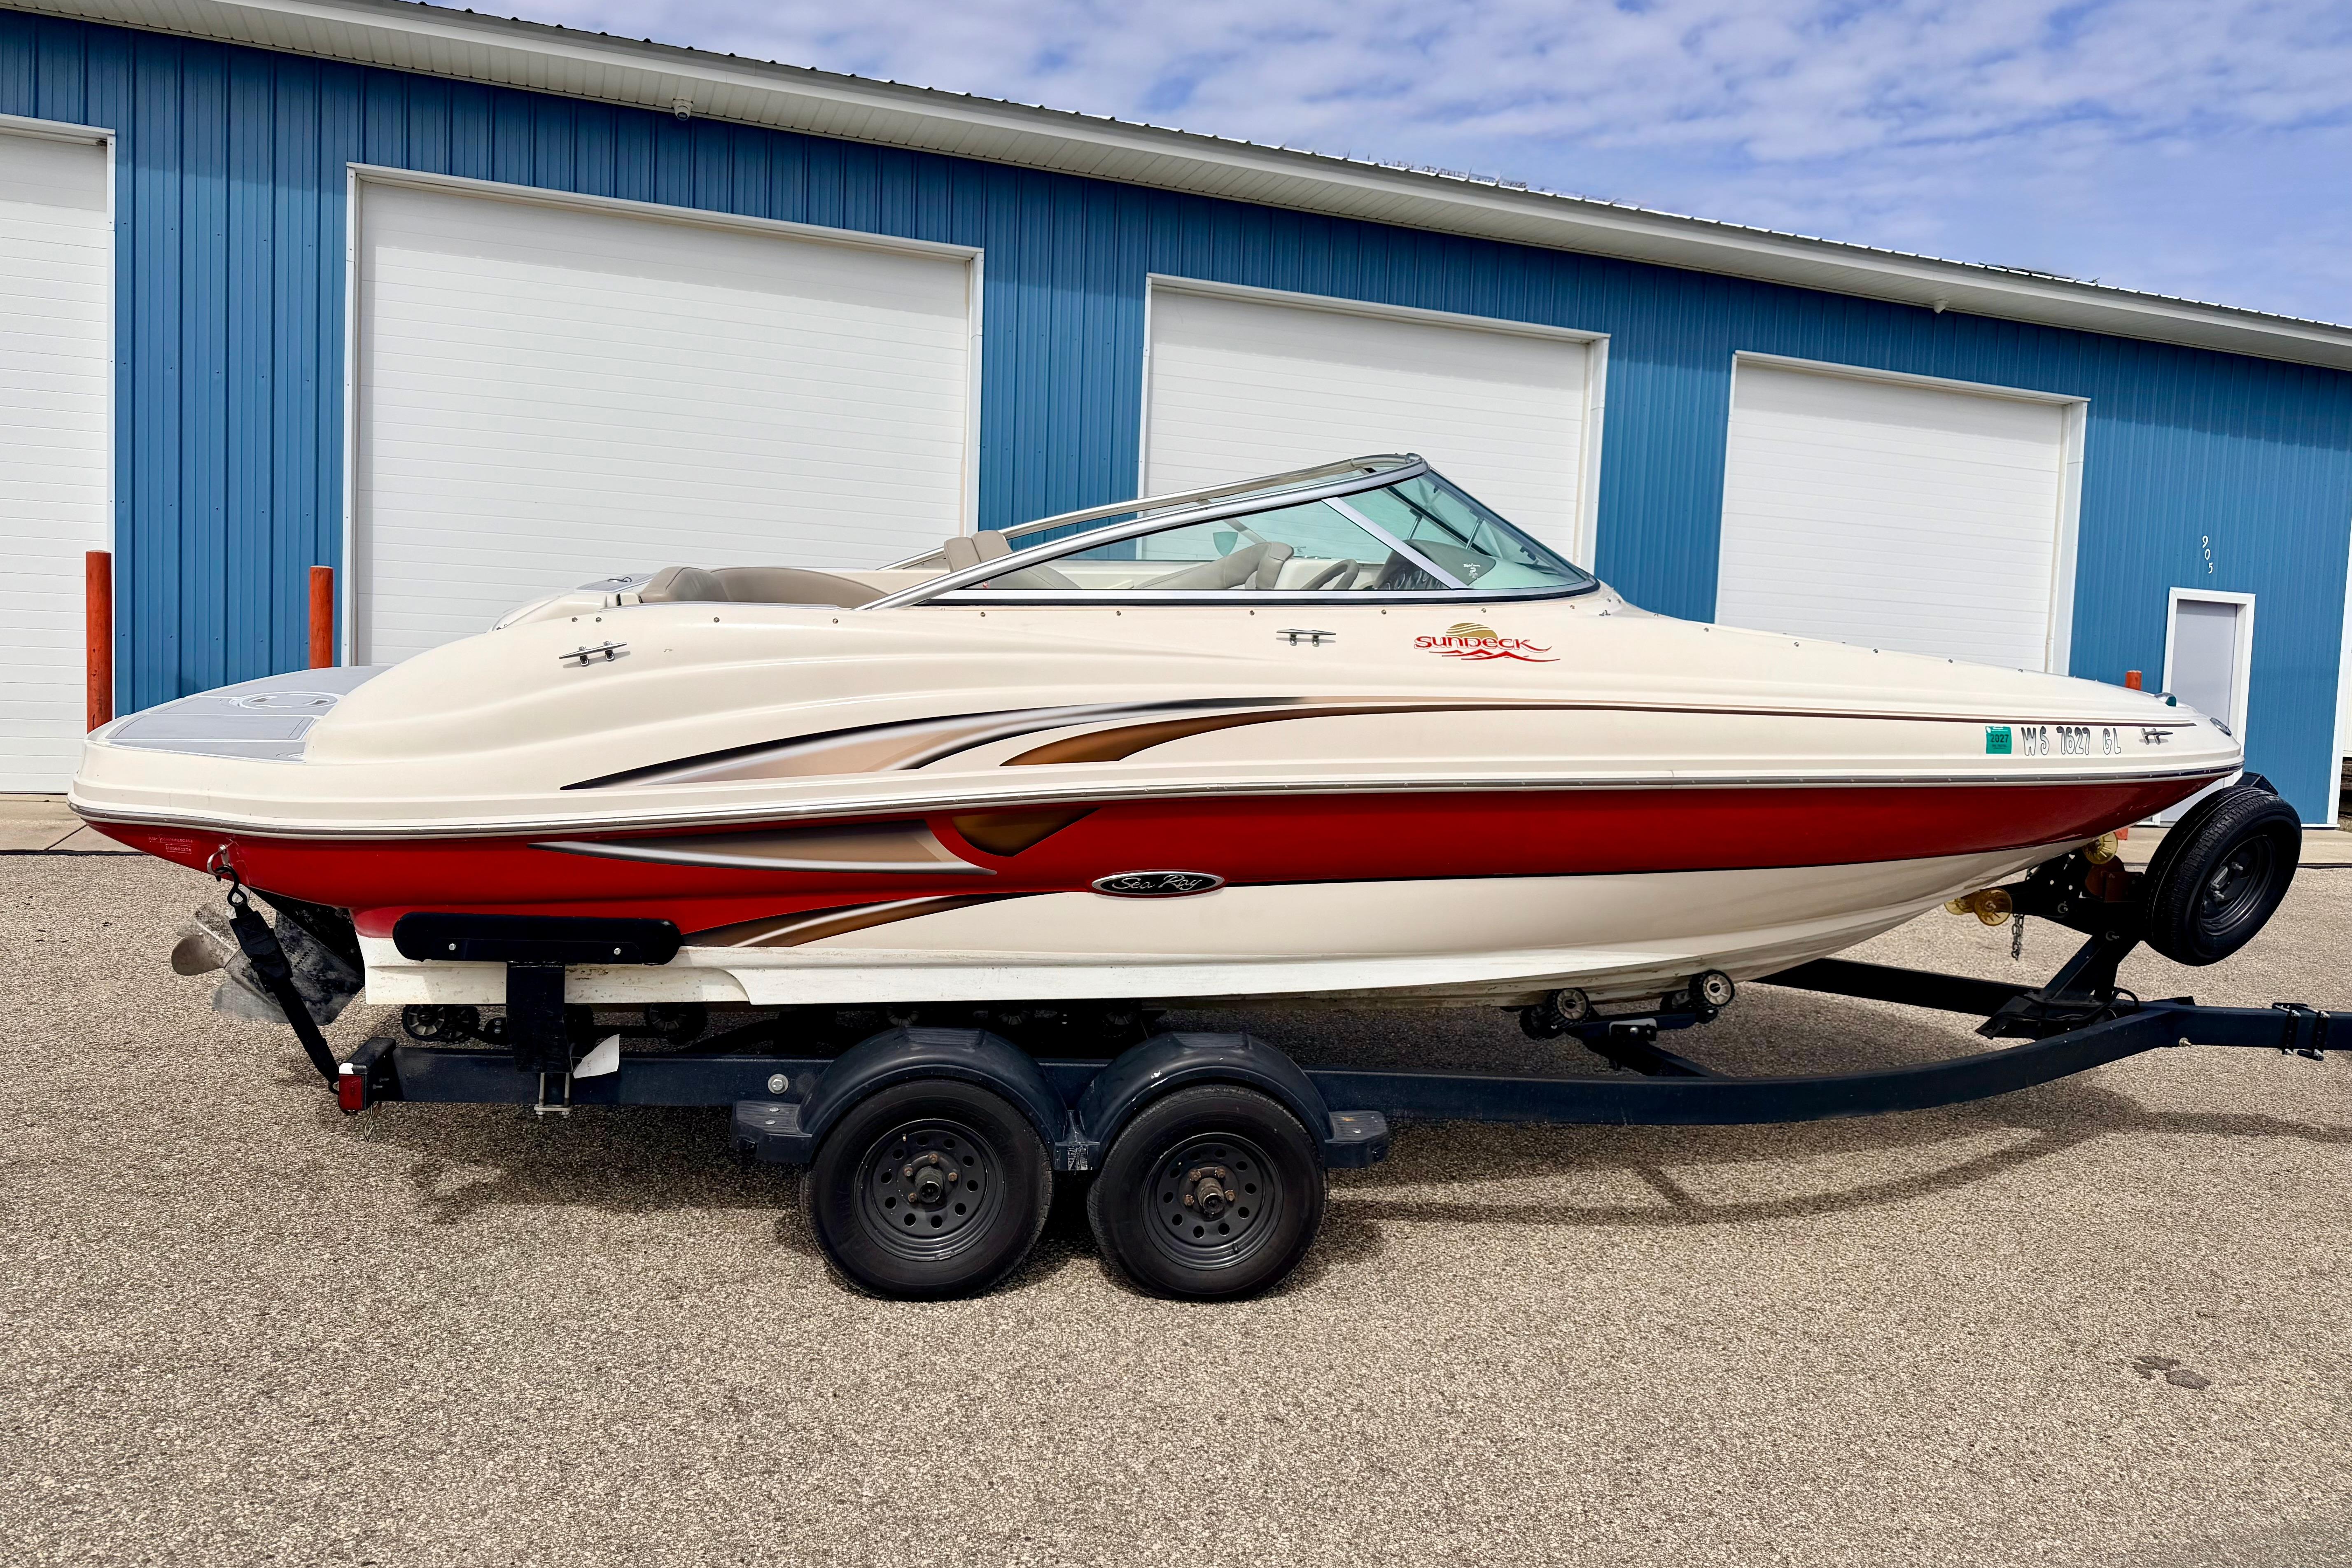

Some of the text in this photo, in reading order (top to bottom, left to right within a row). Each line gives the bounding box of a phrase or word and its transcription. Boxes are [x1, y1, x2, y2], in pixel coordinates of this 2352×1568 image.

[2202, 535, 2213, 574] 905
[1990, 734, 2009, 742] 2027
[2021, 726, 2121, 756] WS 7627 GL
[1112, 875, 1203, 890] Sea Ray
